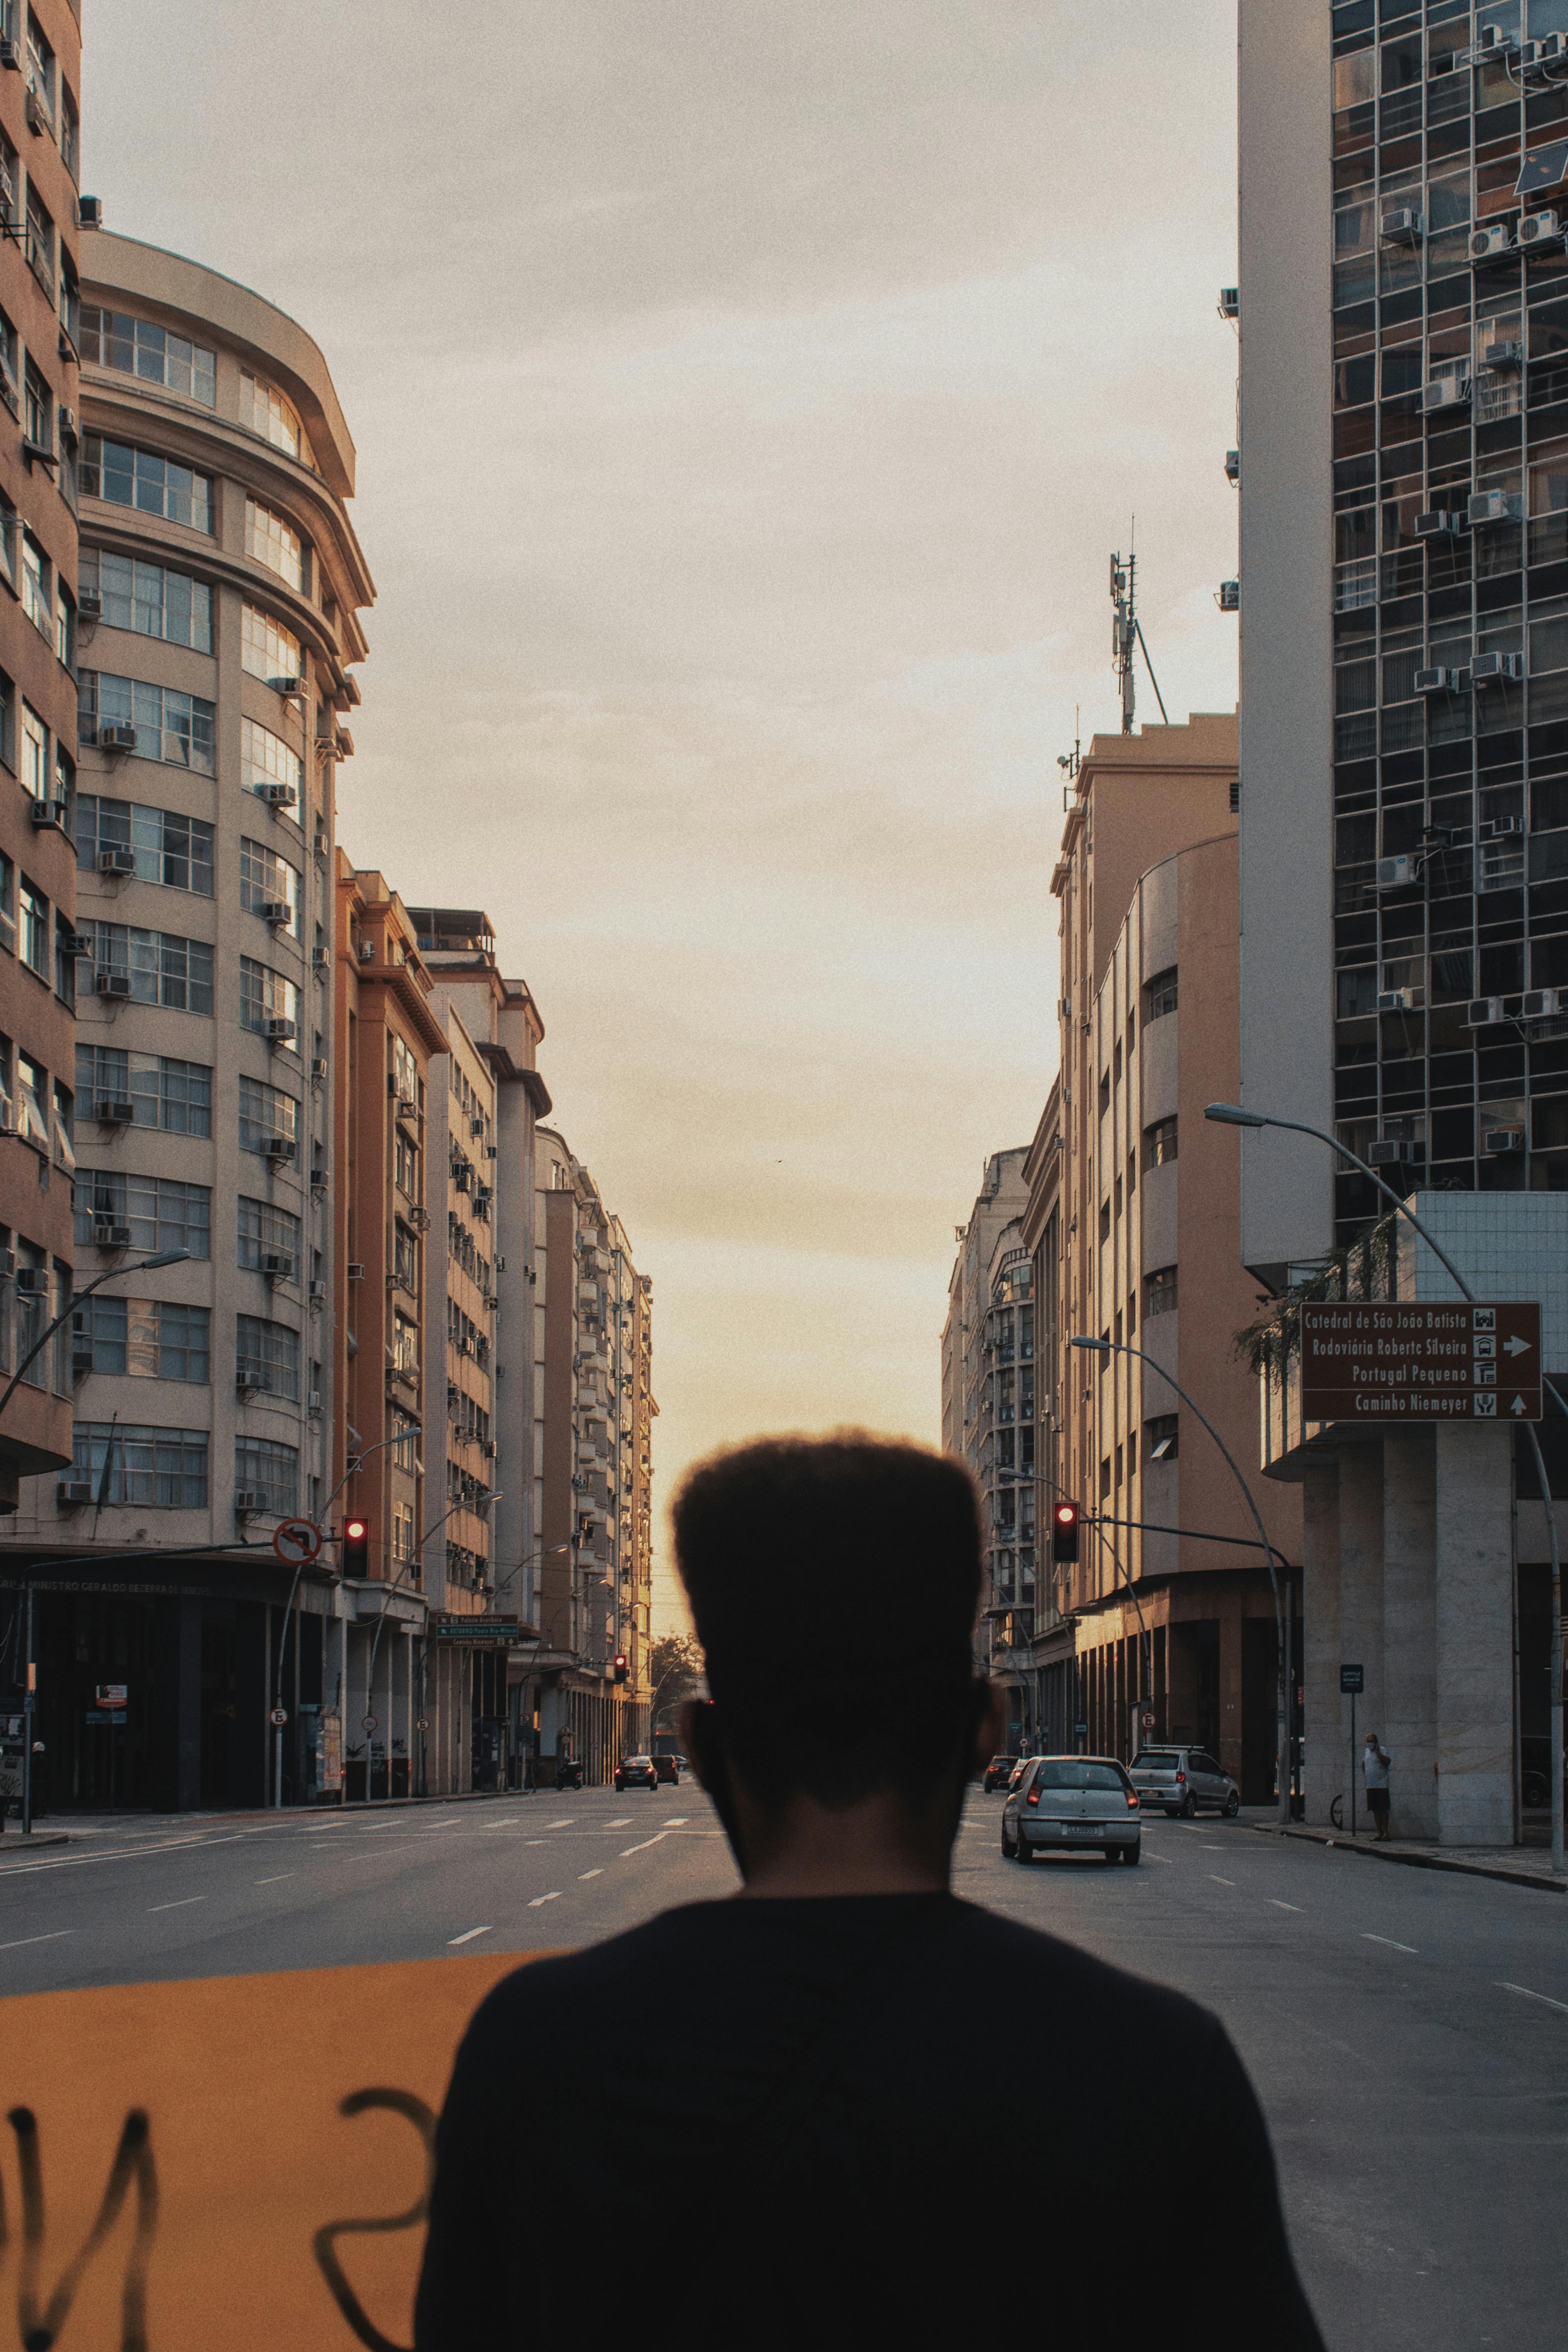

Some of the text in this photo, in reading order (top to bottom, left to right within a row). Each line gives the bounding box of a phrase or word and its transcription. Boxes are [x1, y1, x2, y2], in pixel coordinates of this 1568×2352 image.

[1305, 1311, 1466, 1328] Catedral de São João Batista
[1313, 1338, 1373, 1355] Rodoviária
[1426, 1337, 1467, 1355] Silveira
[1353, 1364, 1467, 1386] Portugal Pequeno
[1355, 1393, 1467, 1414] Caminho Niemeyer
[28, 1581, 79, 1590] MINISTRO
[81, 1582, 127, 1592] GERALDO
[128, 1584, 167, 1593] BEZERRA
